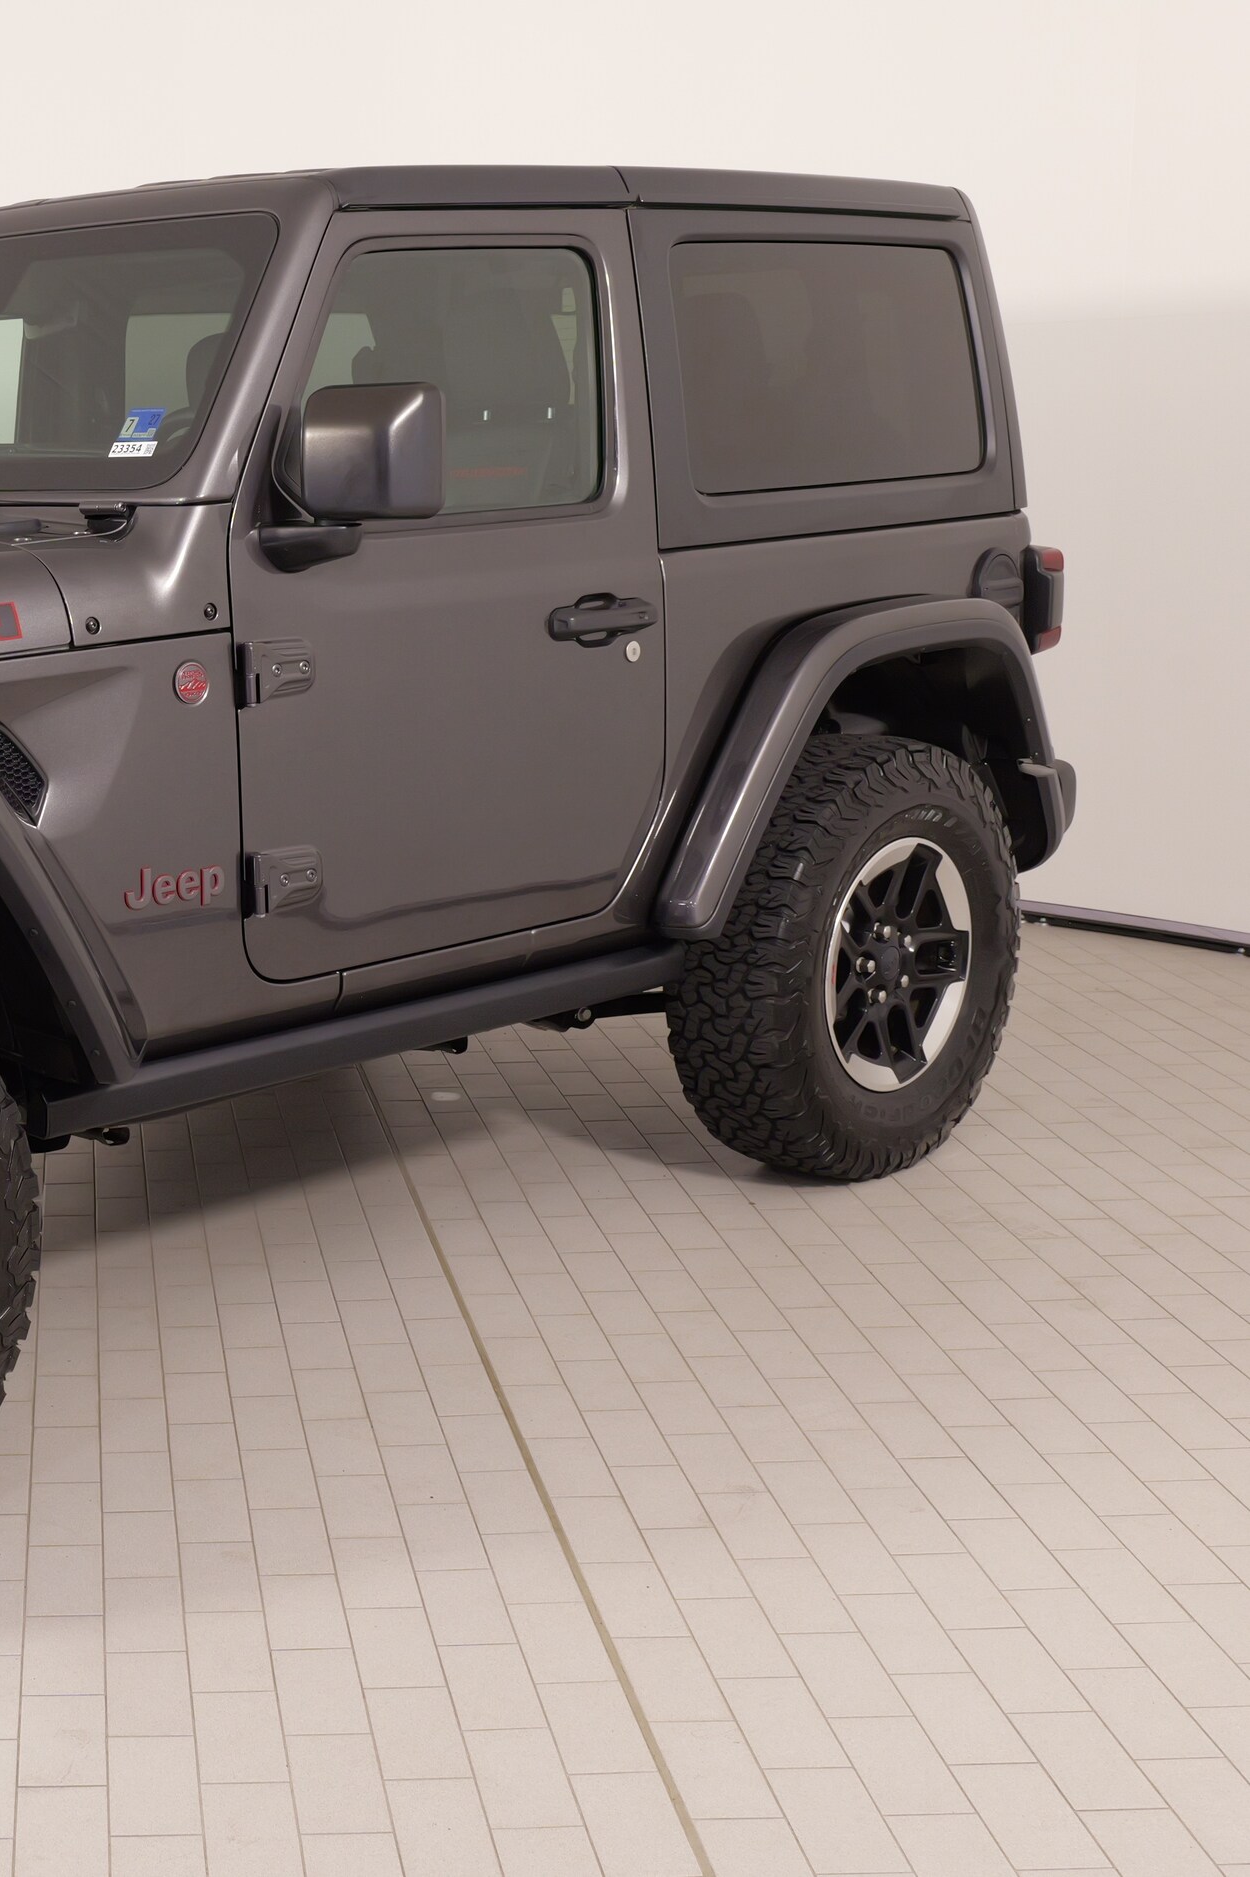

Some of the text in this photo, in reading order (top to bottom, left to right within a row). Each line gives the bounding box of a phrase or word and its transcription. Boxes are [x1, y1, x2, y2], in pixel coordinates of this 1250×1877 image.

[125, 418, 136, 433] 7
[148, 414, 161, 426] 27
[111, 443, 143, 454] 23354
[124, 866, 225, 910] Jeep
